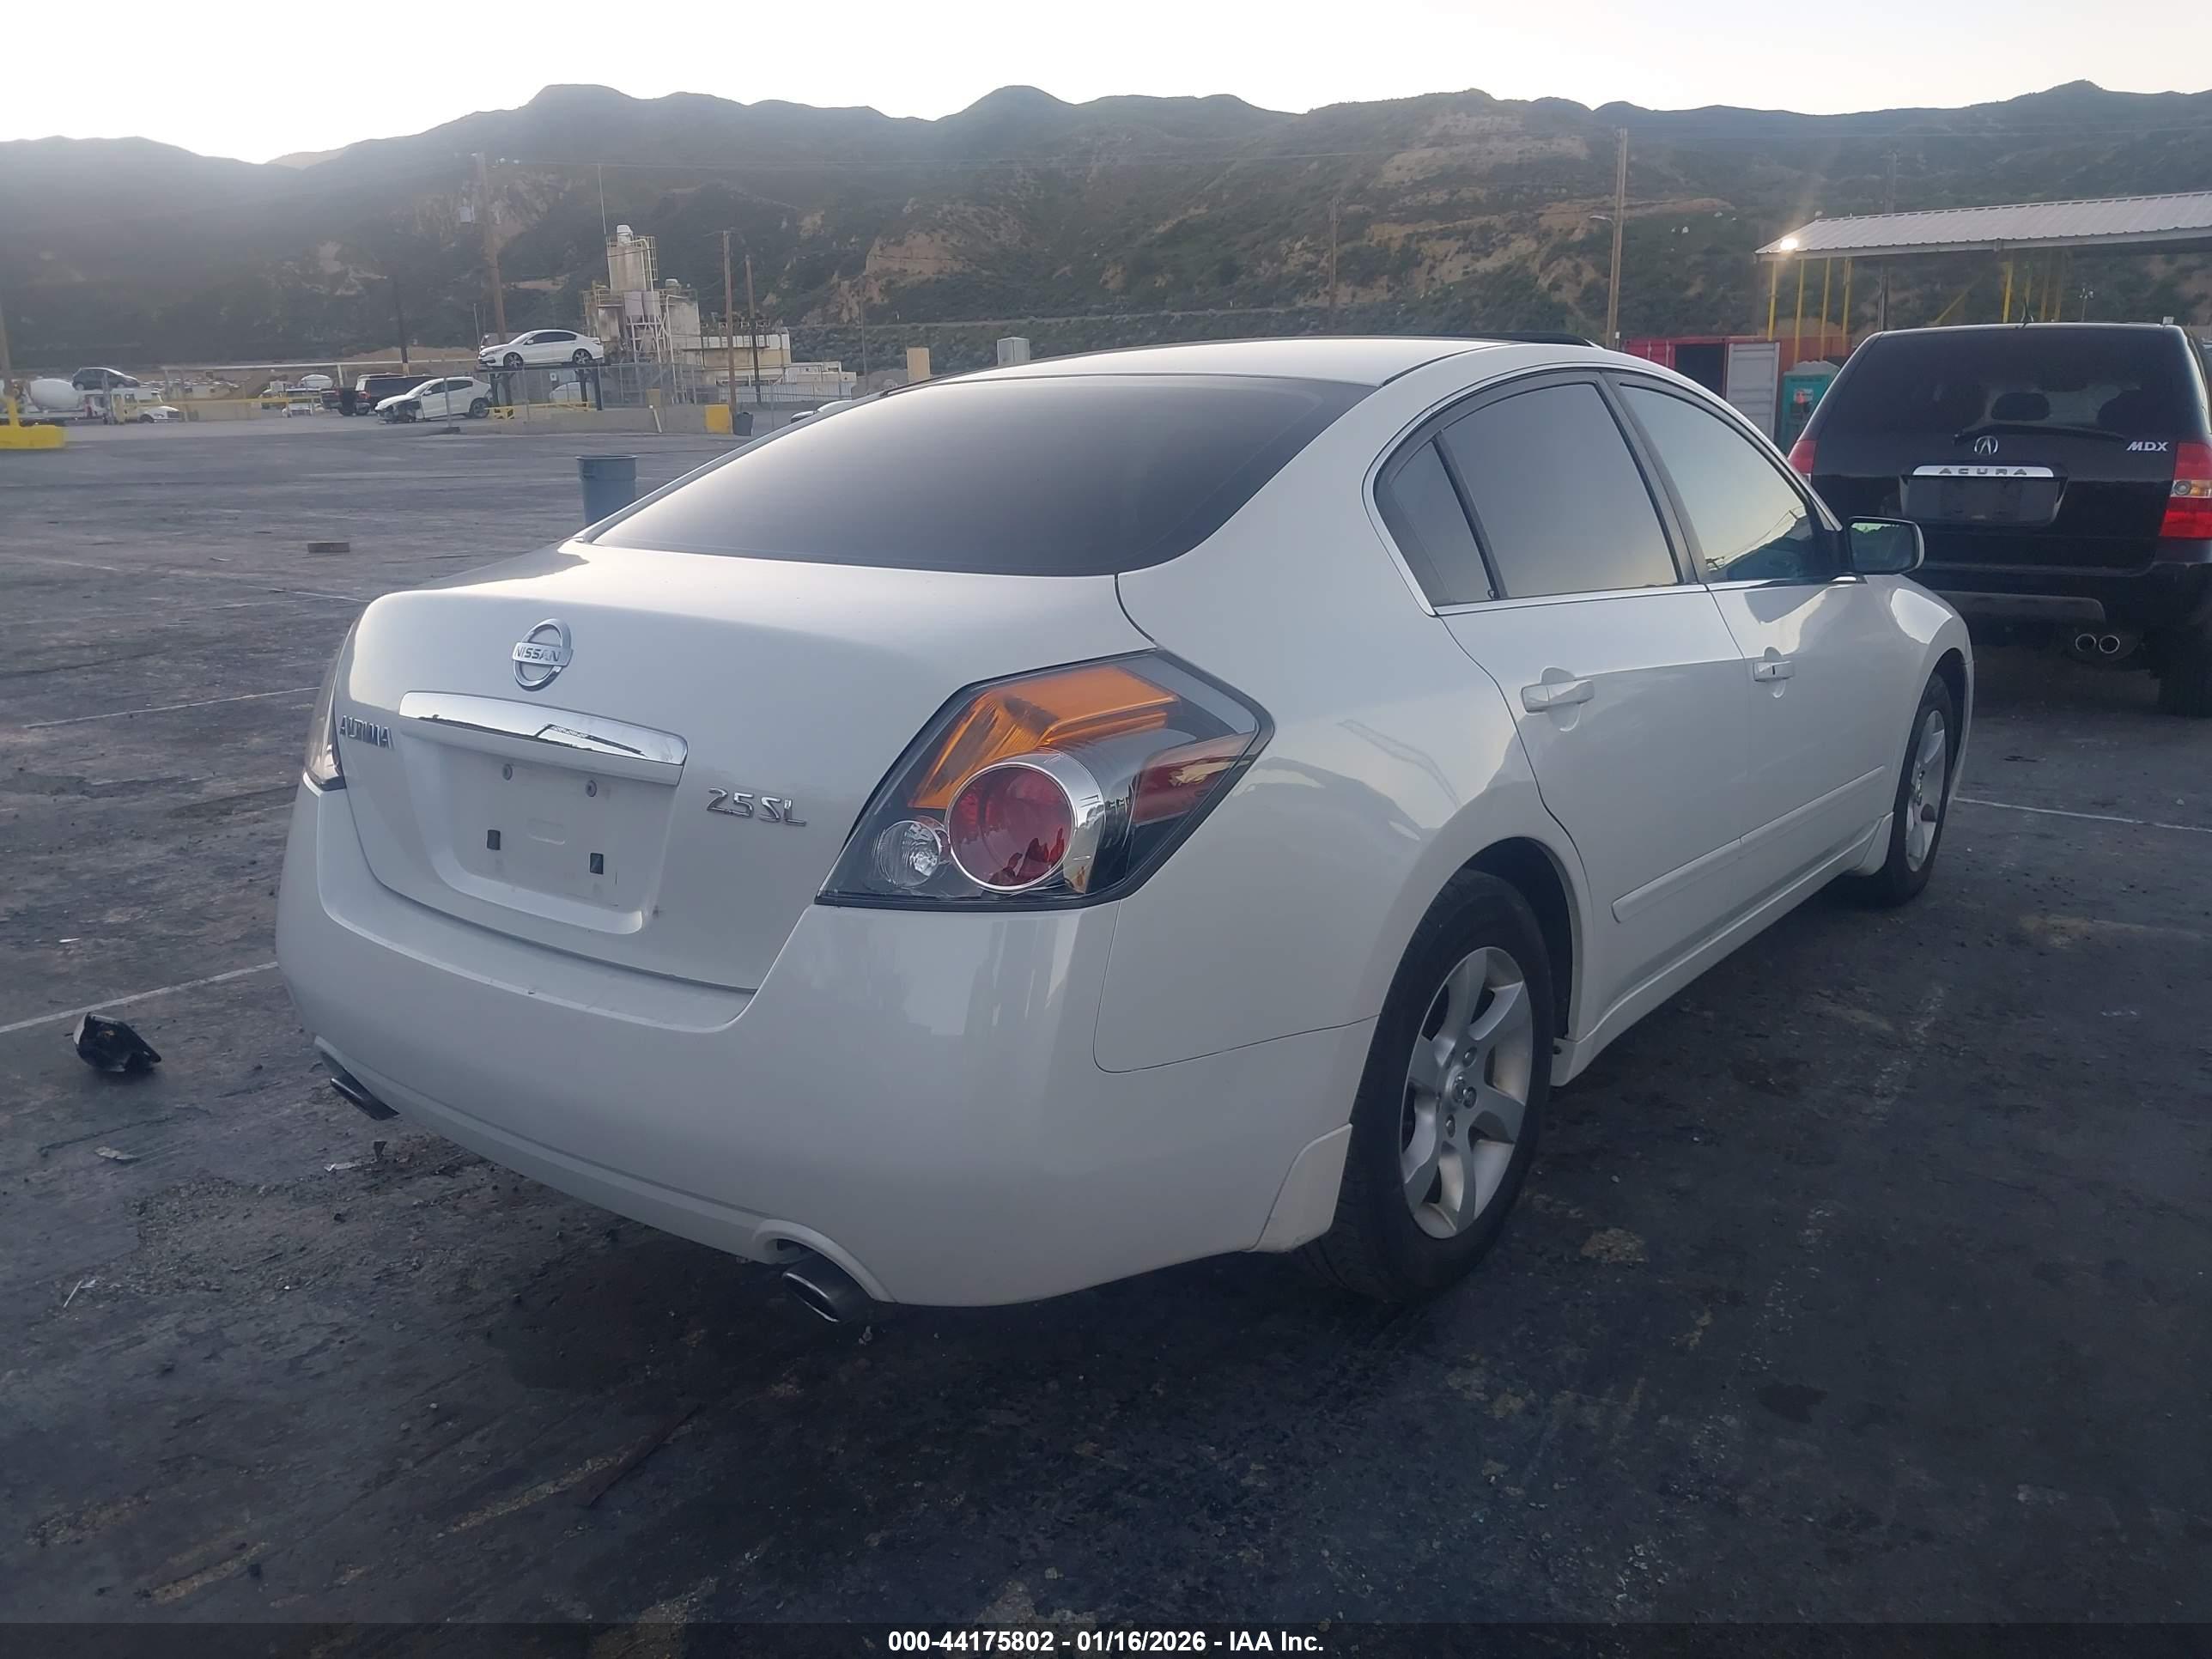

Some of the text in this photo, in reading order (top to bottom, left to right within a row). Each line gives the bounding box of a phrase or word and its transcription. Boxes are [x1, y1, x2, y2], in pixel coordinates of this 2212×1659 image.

[2126, 441, 2169, 452] MDX
[1938, 466, 2027, 477] ACURA
[514, 643, 562, 663] NISSAN
[339, 714, 395, 750] ALTIMA
[757, 795, 807, 827] SL
